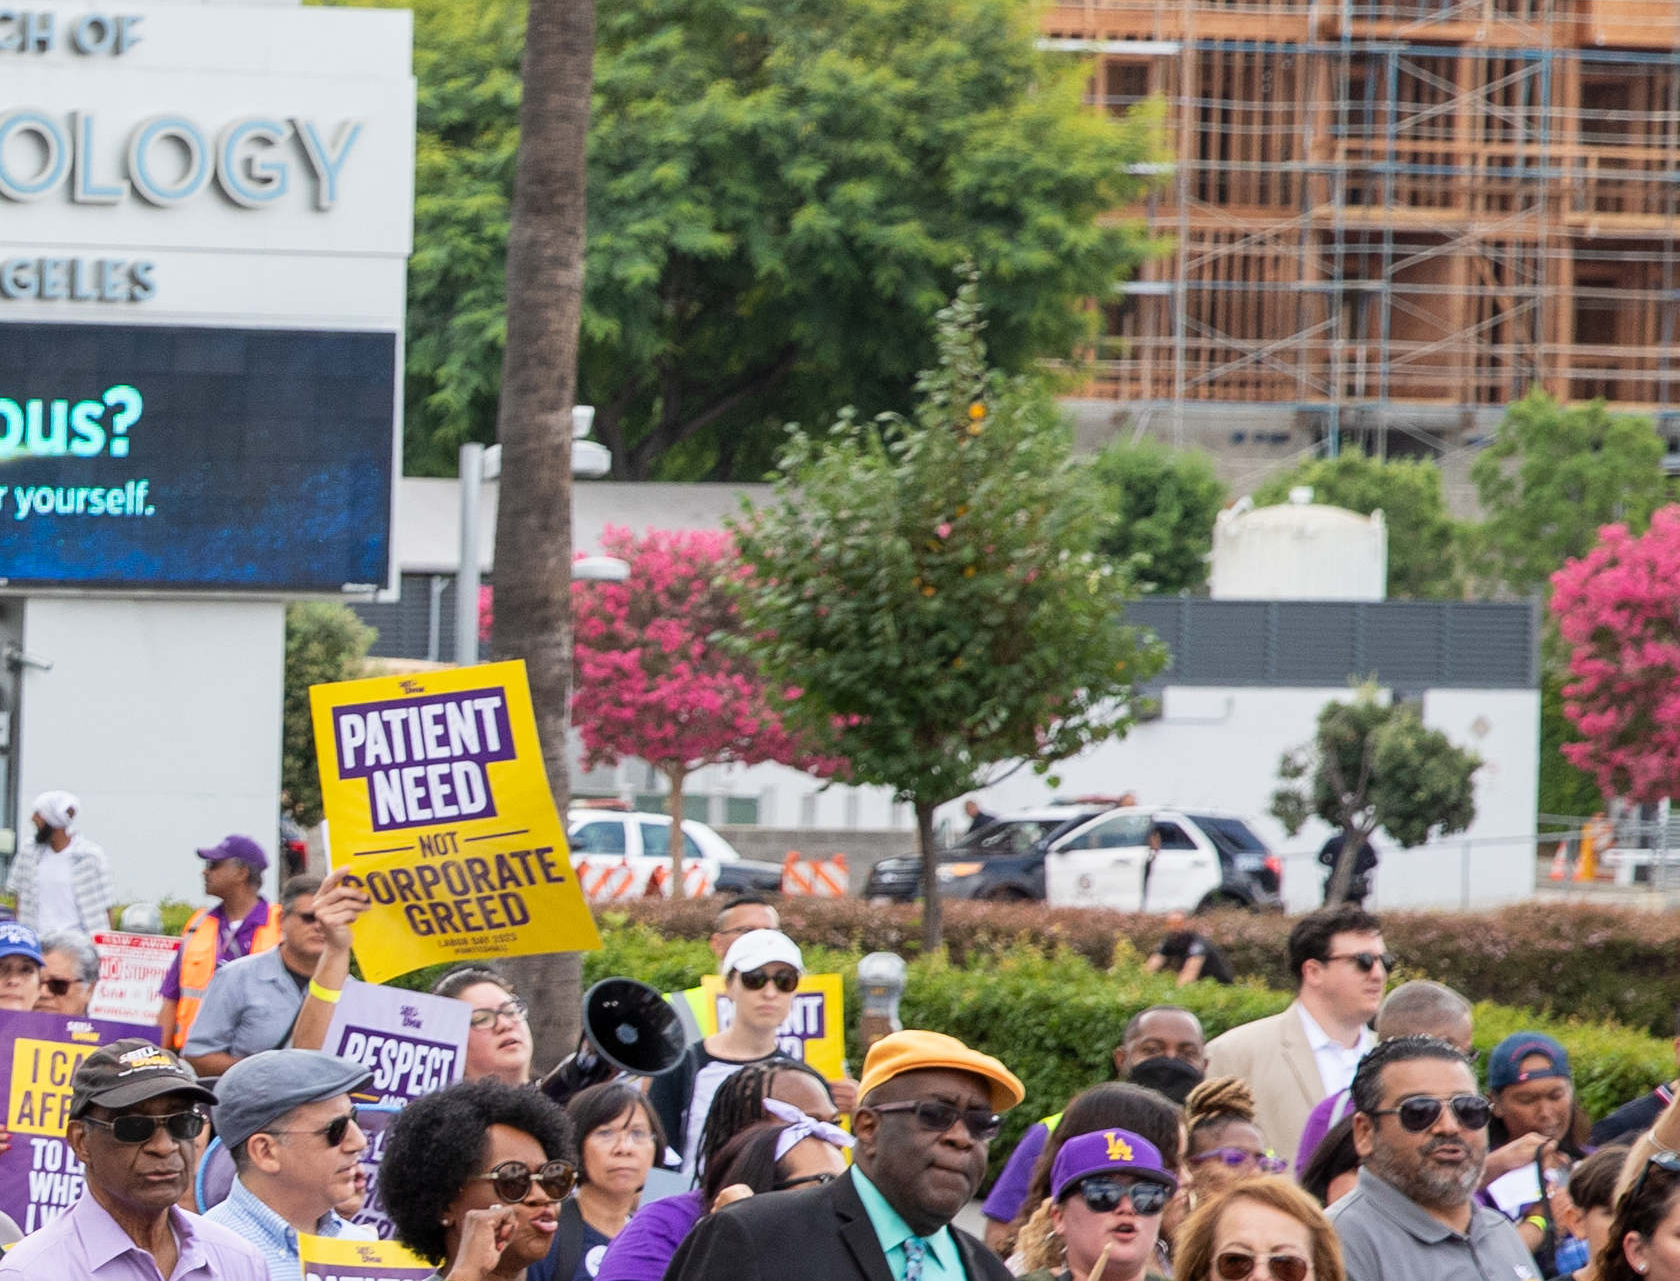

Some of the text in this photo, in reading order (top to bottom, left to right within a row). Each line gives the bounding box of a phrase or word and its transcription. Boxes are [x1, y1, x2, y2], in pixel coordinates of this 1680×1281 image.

[71, 13, 144, 55] OF
[15, 480, 155, 518] yourself.
[338, 696, 504, 769] PATIENT
[371, 761, 488, 827] NEED
[405, 892, 530, 937] GREED
